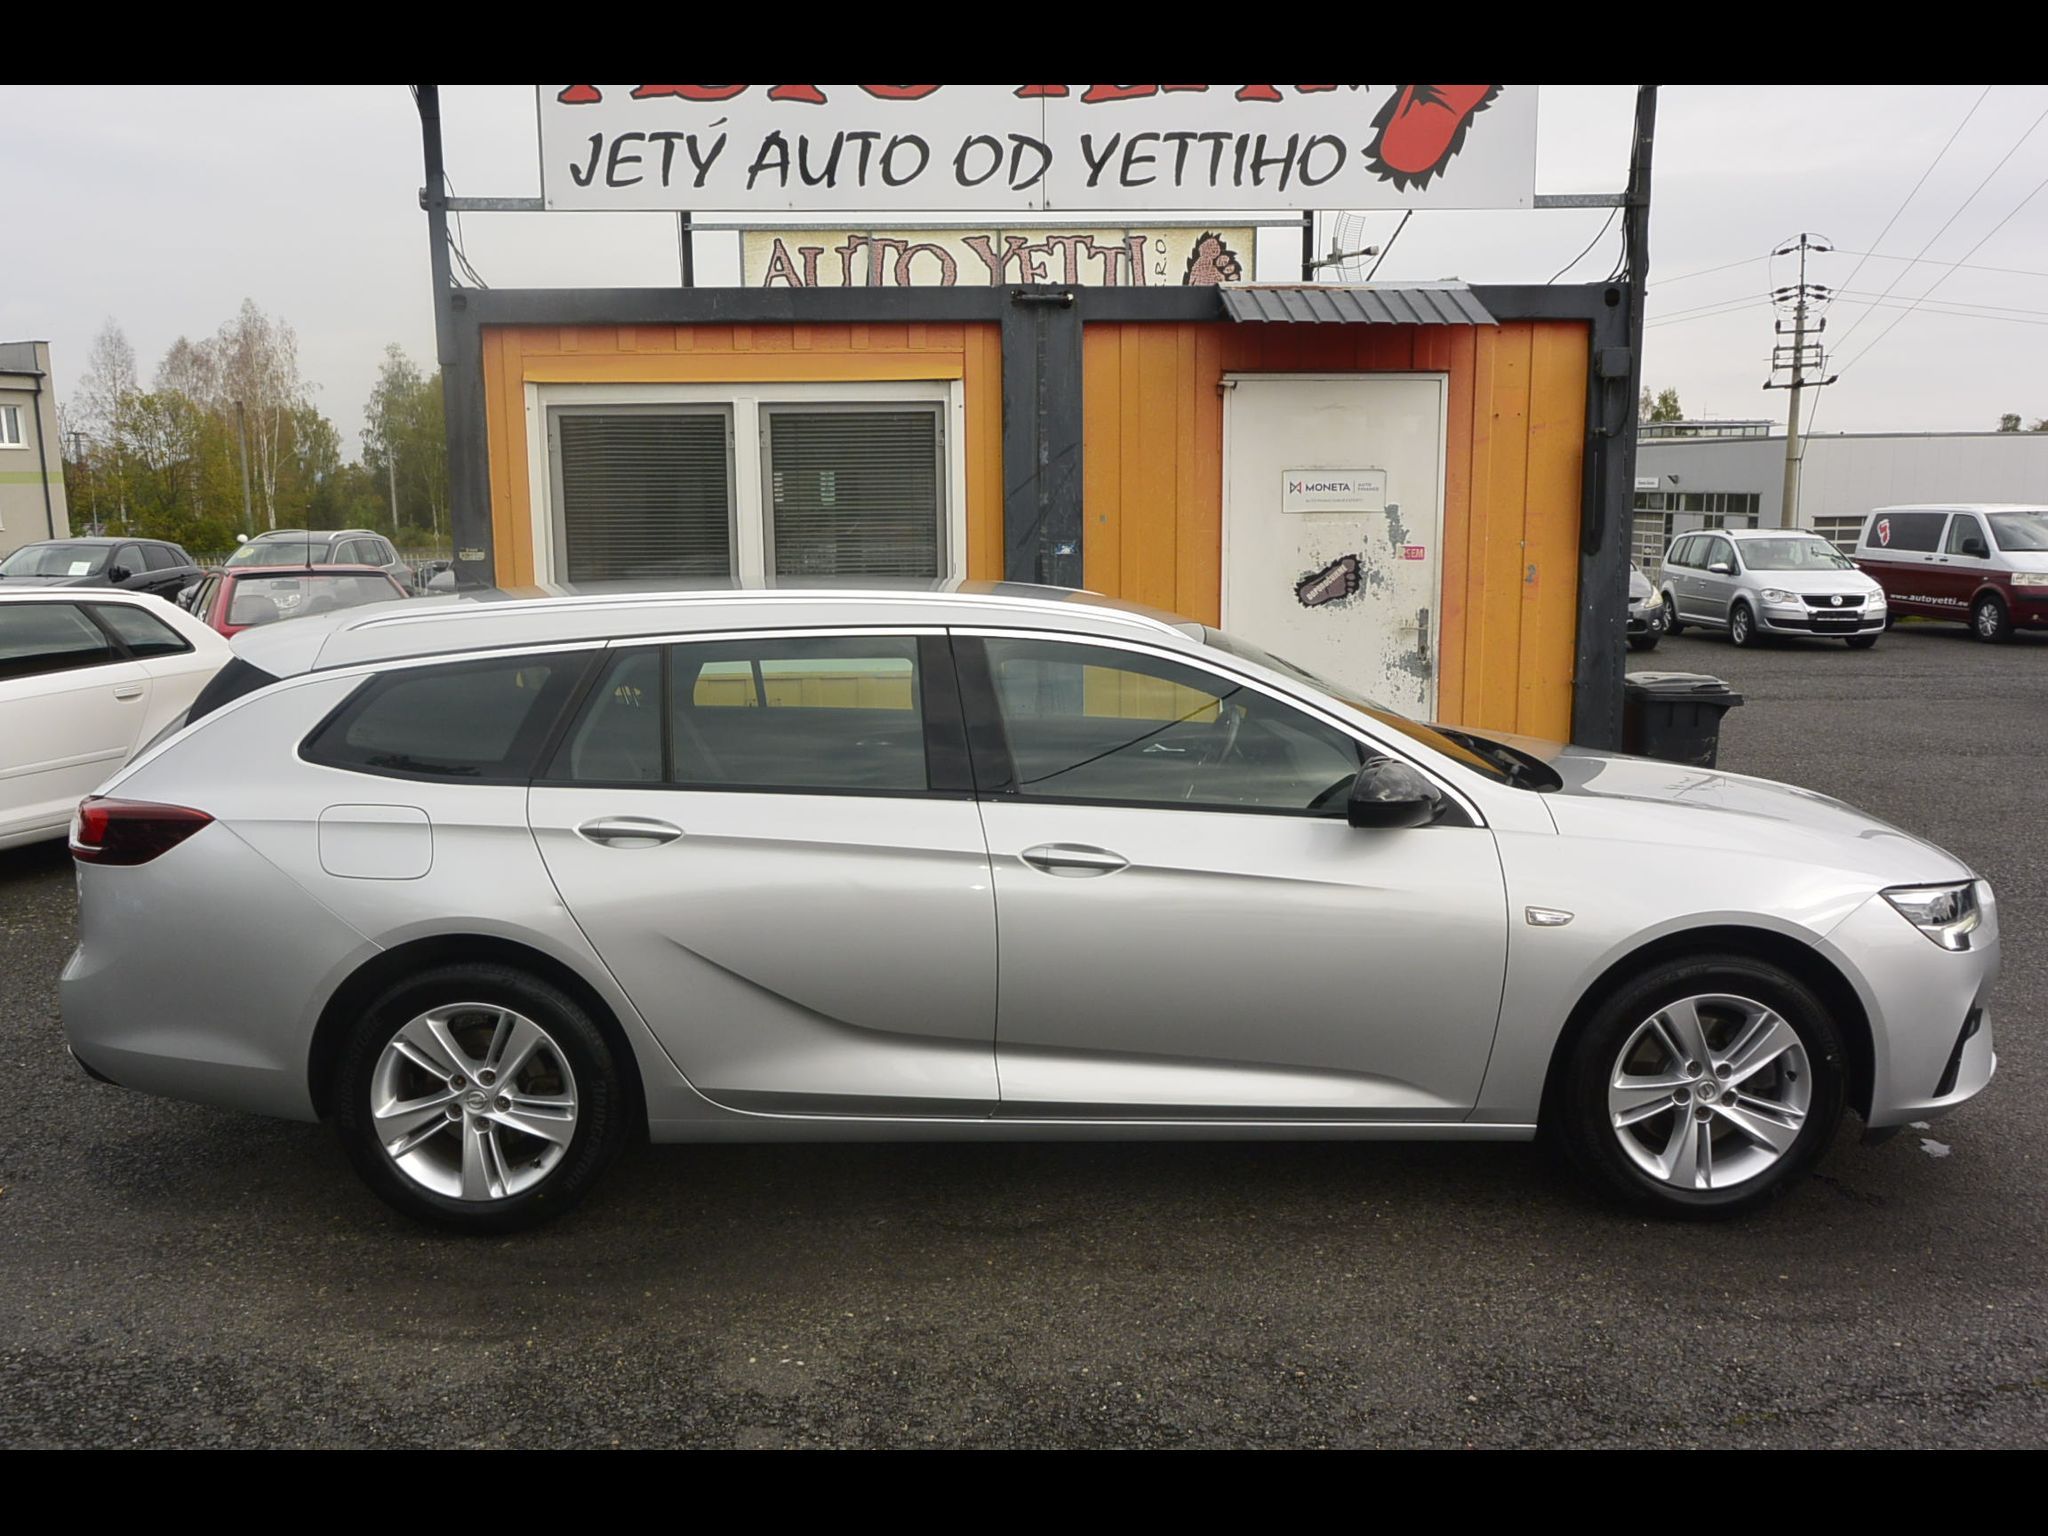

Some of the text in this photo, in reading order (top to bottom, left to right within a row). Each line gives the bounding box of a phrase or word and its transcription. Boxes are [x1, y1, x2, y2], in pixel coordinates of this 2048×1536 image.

[569, 116, 1348, 191] JETÝ AUTO OD YETTIHO
[763, 234, 1148, 287] AUTO YETTI
[1305, 482, 1351, 492] MONETA
